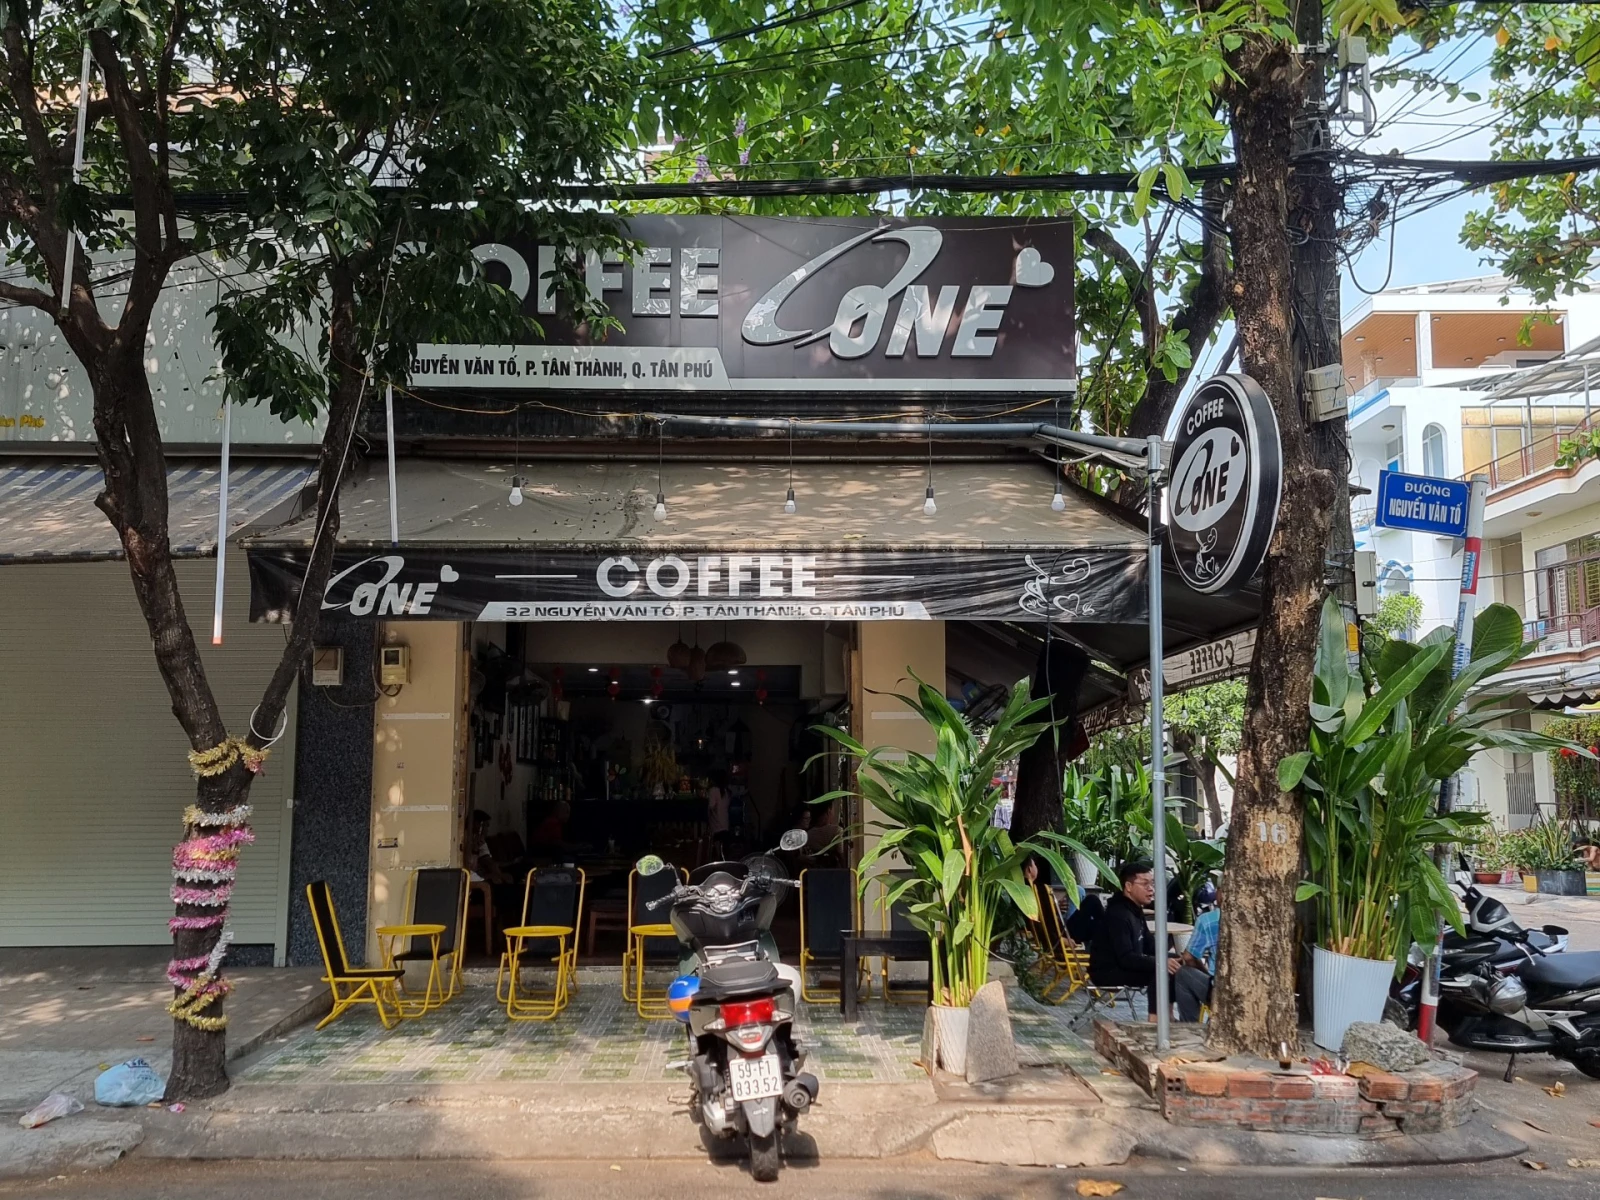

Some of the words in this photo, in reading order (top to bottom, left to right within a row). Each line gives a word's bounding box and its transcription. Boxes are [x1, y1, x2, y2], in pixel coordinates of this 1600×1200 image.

[394, 240, 719, 317] OFFEE
[411, 354, 459, 375] GUYỄN
[465, 357, 494, 375] VĂN
[498, 355, 521, 377] TỐ,
[526, 361, 538, 376] P.
[541, 358, 570, 376] TÂN
[575, 359, 627, 378] THÀNH,
[632, 362, 646, 378] Q.
[650, 359, 679, 378] TÂN
[683, 360, 713, 378] PHÚ
[1186, 398, 1224, 436] COFFEE
[1404, 482, 1451, 497] ĐƯỜNG
[1388, 496, 1427, 520] NGUYỄN
[1428, 501, 1448, 524] VĂN
[1449, 502, 1463, 525] TỐ
[596, 555, 816, 597] COFFEE
[506, 606, 531, 617] 32
[535, 602, 606, 617] NGUYỄN
[609, 604, 648, 617] VĂN
[683, 606, 699, 617] P.
[705, 603, 740, 617] TÂN
[809, 606, 827, 617] Q.
[830, 603, 871, 617] TÂN
[872, 603, 905, 617] PHÚ
[1256, 821, 1287, 845] 16
[737, 1060, 771, 1079] 59-F1
[735, 1076, 779, 1097] 833.52
